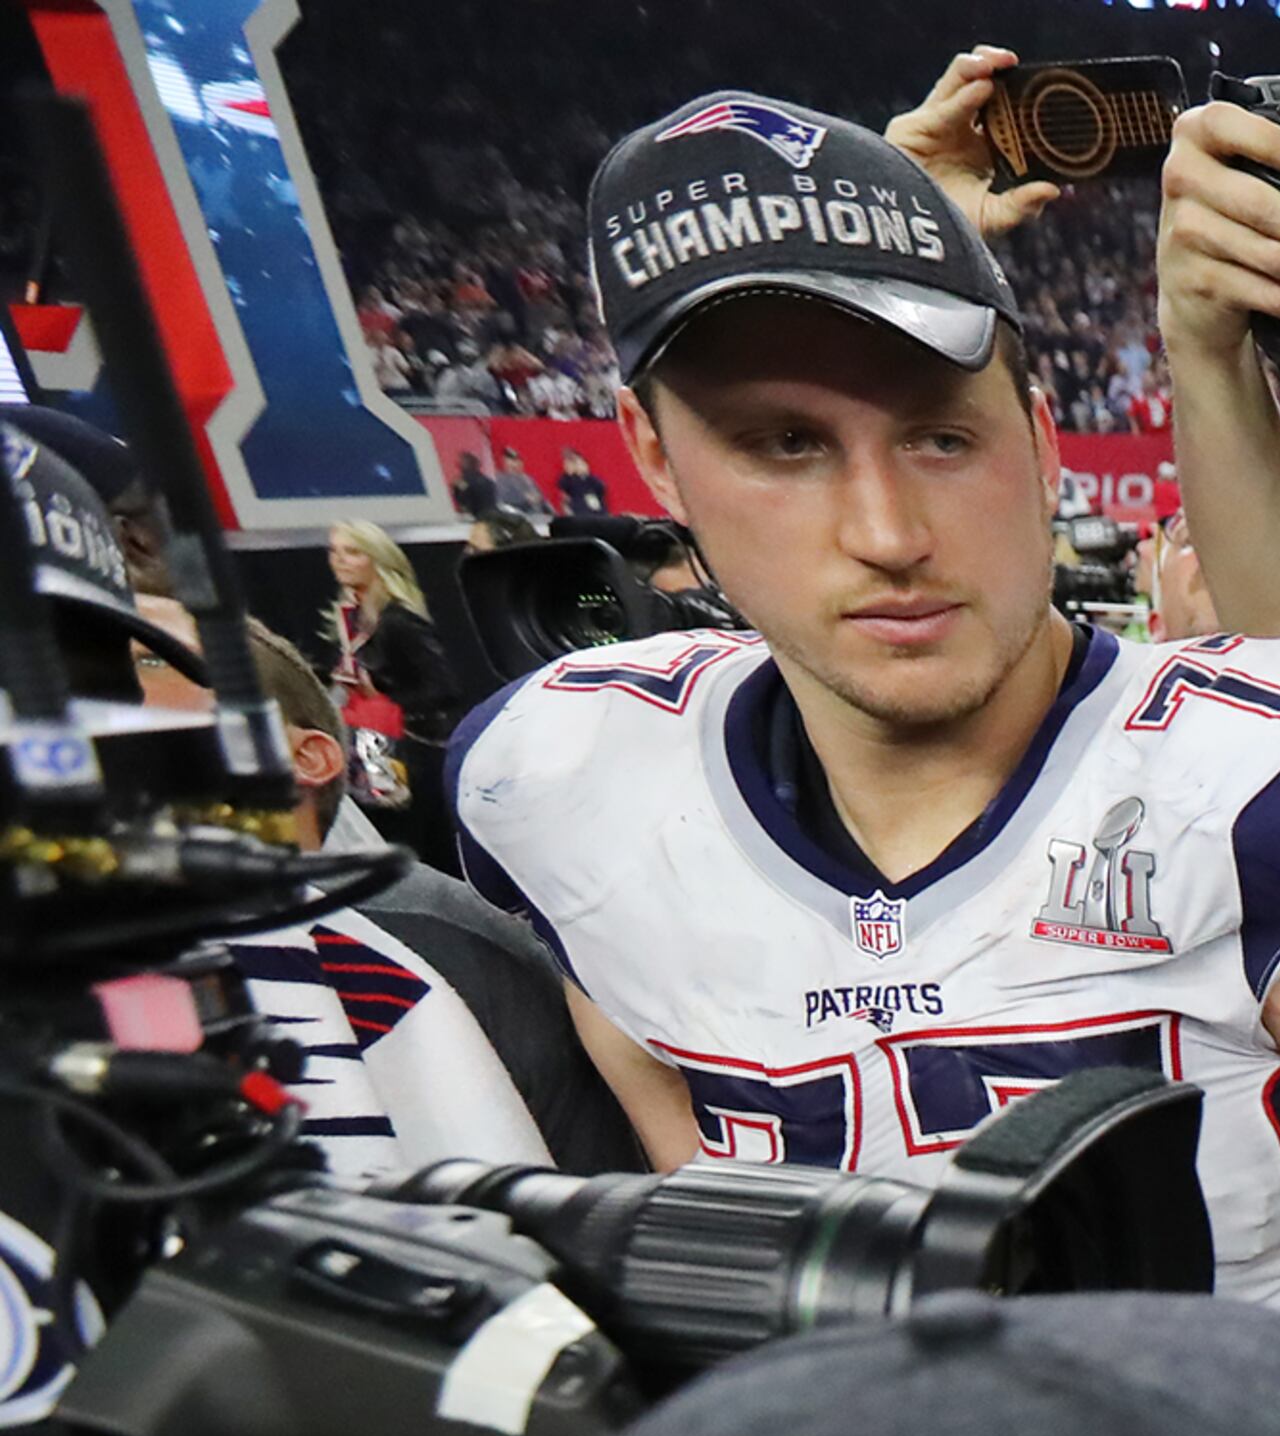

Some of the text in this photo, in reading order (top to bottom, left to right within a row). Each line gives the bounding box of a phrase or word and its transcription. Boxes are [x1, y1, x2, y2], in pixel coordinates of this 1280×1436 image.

[606, 173, 931, 237] SUPER BOWL
[612, 194, 945, 288] CHAMPIONS
[1070, 471, 1154, 508] PIO
[859, 922, 898, 953] NFL
[1046, 925, 1151, 949] SUPER BOWL
[804, 982, 944, 1029] PATRIOTS
